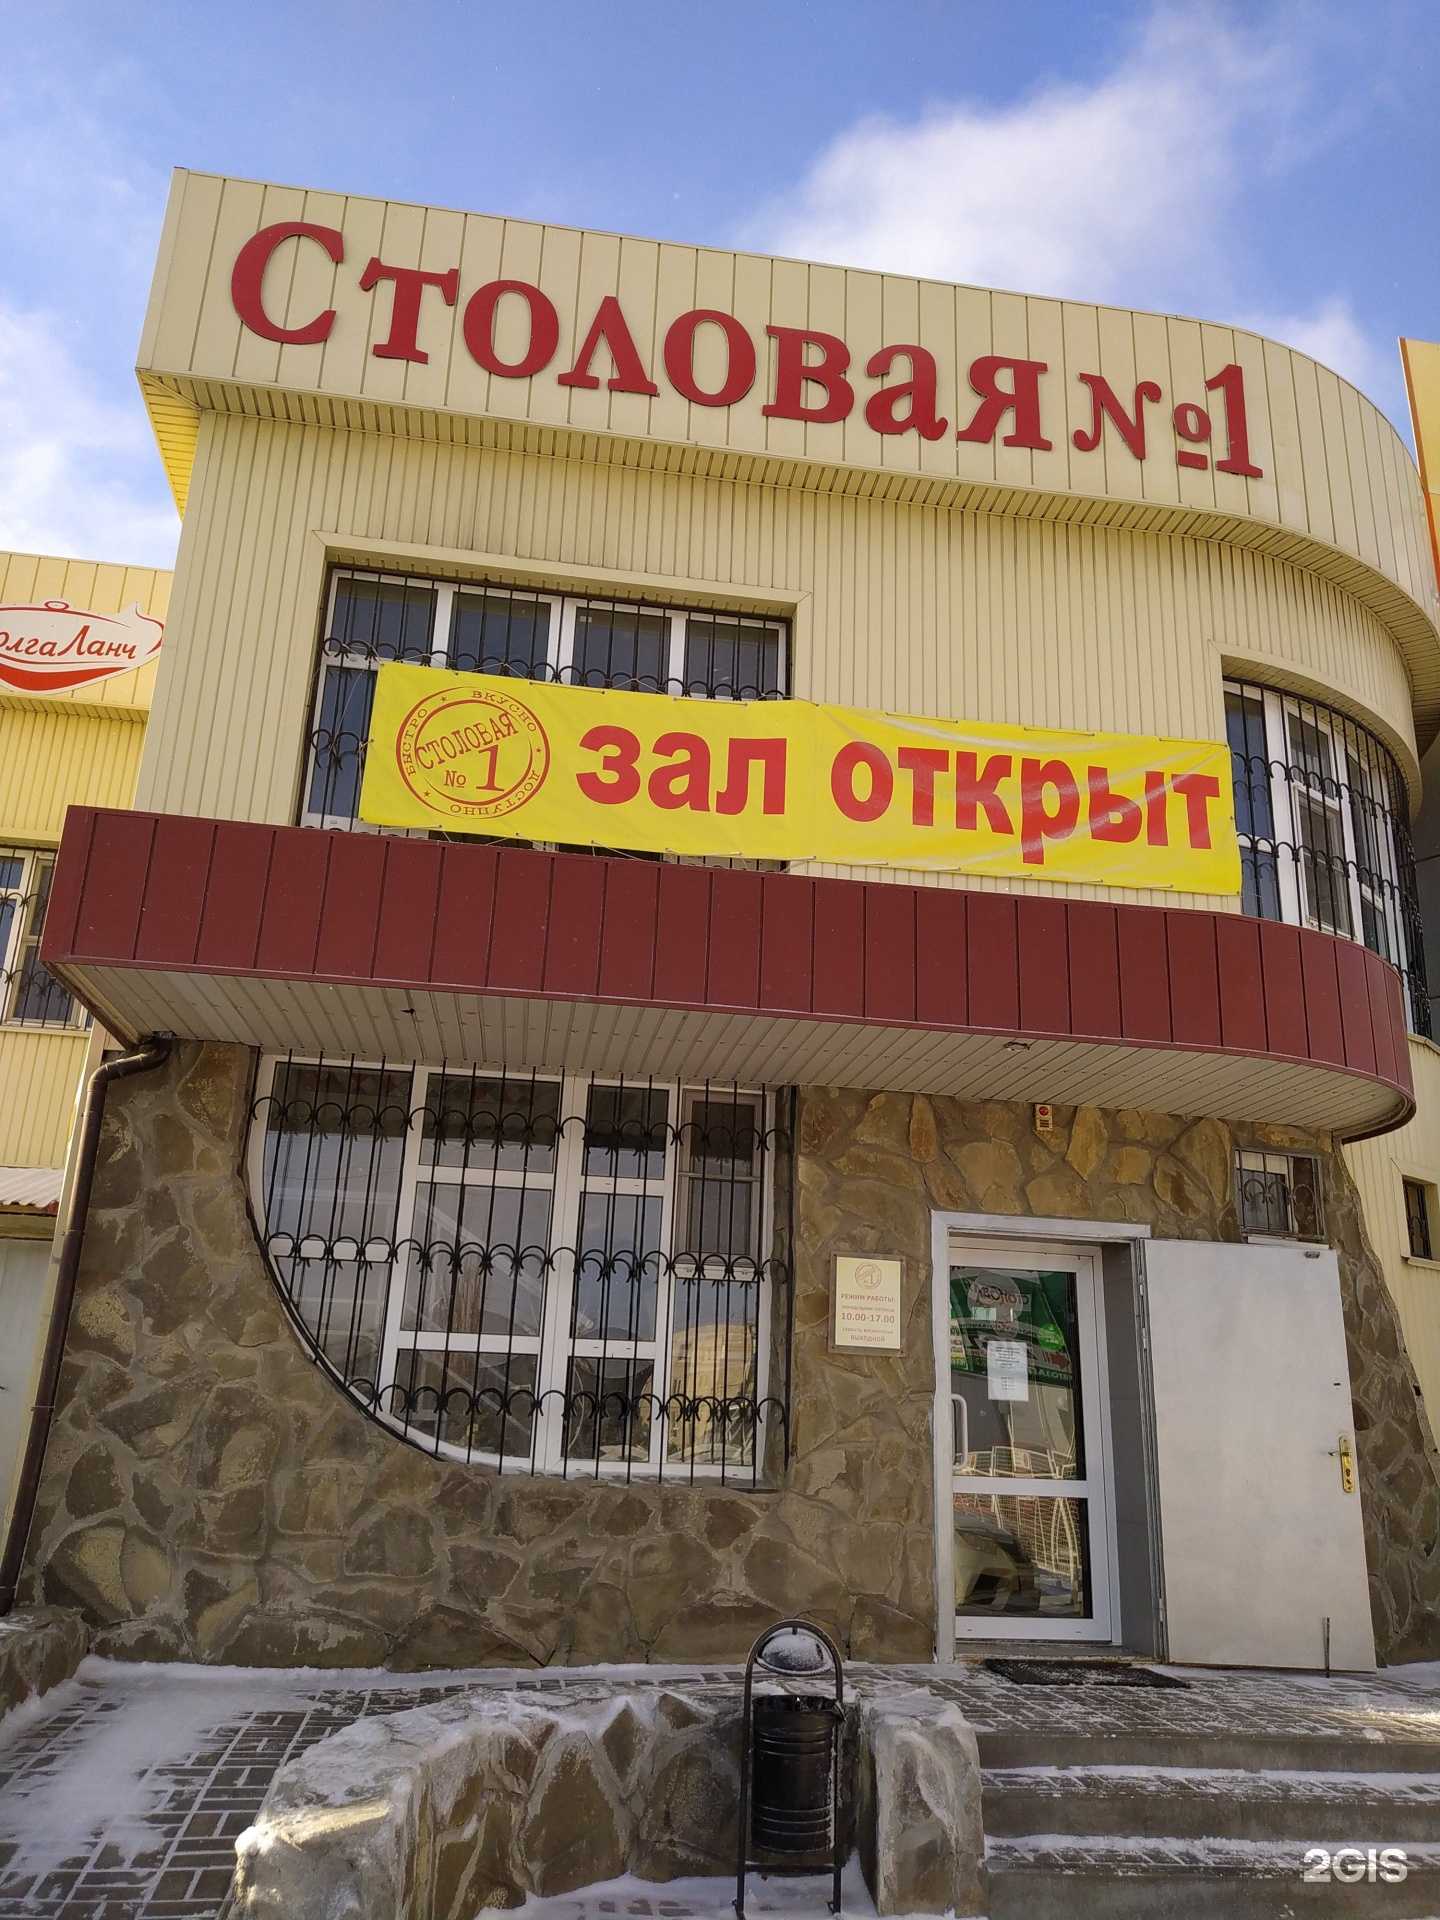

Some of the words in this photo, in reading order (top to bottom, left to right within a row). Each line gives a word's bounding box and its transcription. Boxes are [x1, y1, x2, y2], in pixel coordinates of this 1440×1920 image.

[231, 221, 1053, 451] Столовая
[1073, 363, 1263, 478] №1
[402, 708, 428, 776] БЫСТРО
[415, 712, 519, 770] СТОЛОВАЯ
[471, 690, 537, 732] ВКУСНО
[450, 770, 540, 815] ДОСТУПНО
[576, 724, 787, 815] зал
[831, 740, 1220, 865] открыт
